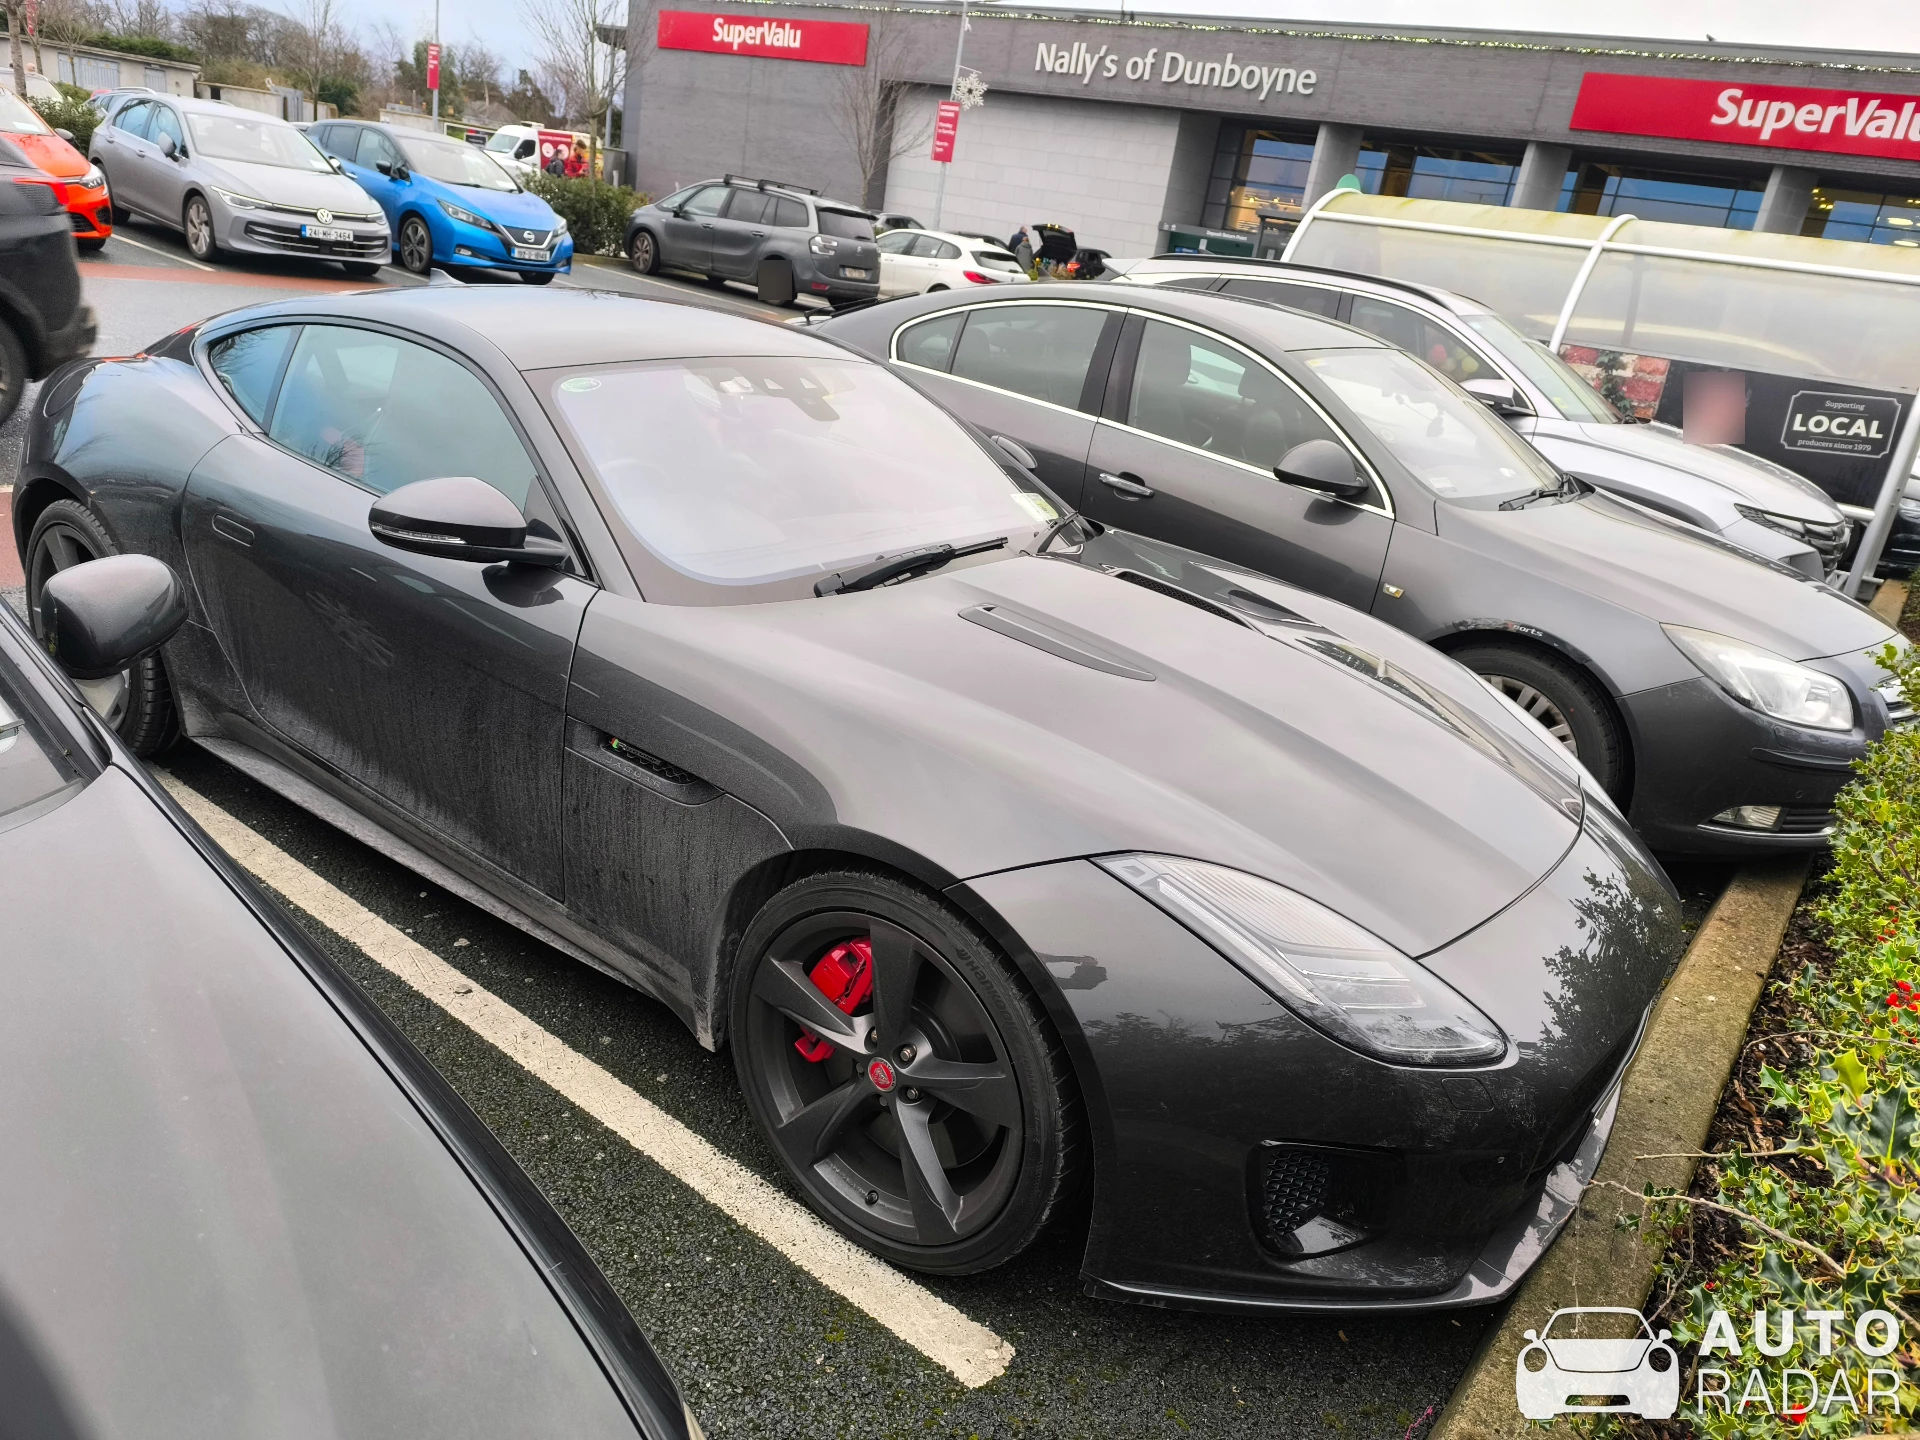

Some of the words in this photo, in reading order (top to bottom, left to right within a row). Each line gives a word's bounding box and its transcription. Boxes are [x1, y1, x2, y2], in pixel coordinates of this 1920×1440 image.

[712, 17, 801, 51] SuperValu
[1034, 41, 1119, 85] Nally's
[1125, 47, 1158, 80] of
[1161, 51, 1317, 101] Dunboyne
[1824, 400, 1866, 411] Supporting
[1792, 413, 1884, 439] LOCAL
[1796, 439, 1834, 449] producers
[1833, 442, 1854, 450] since
[1853, 443, 1872, 452] 1979
